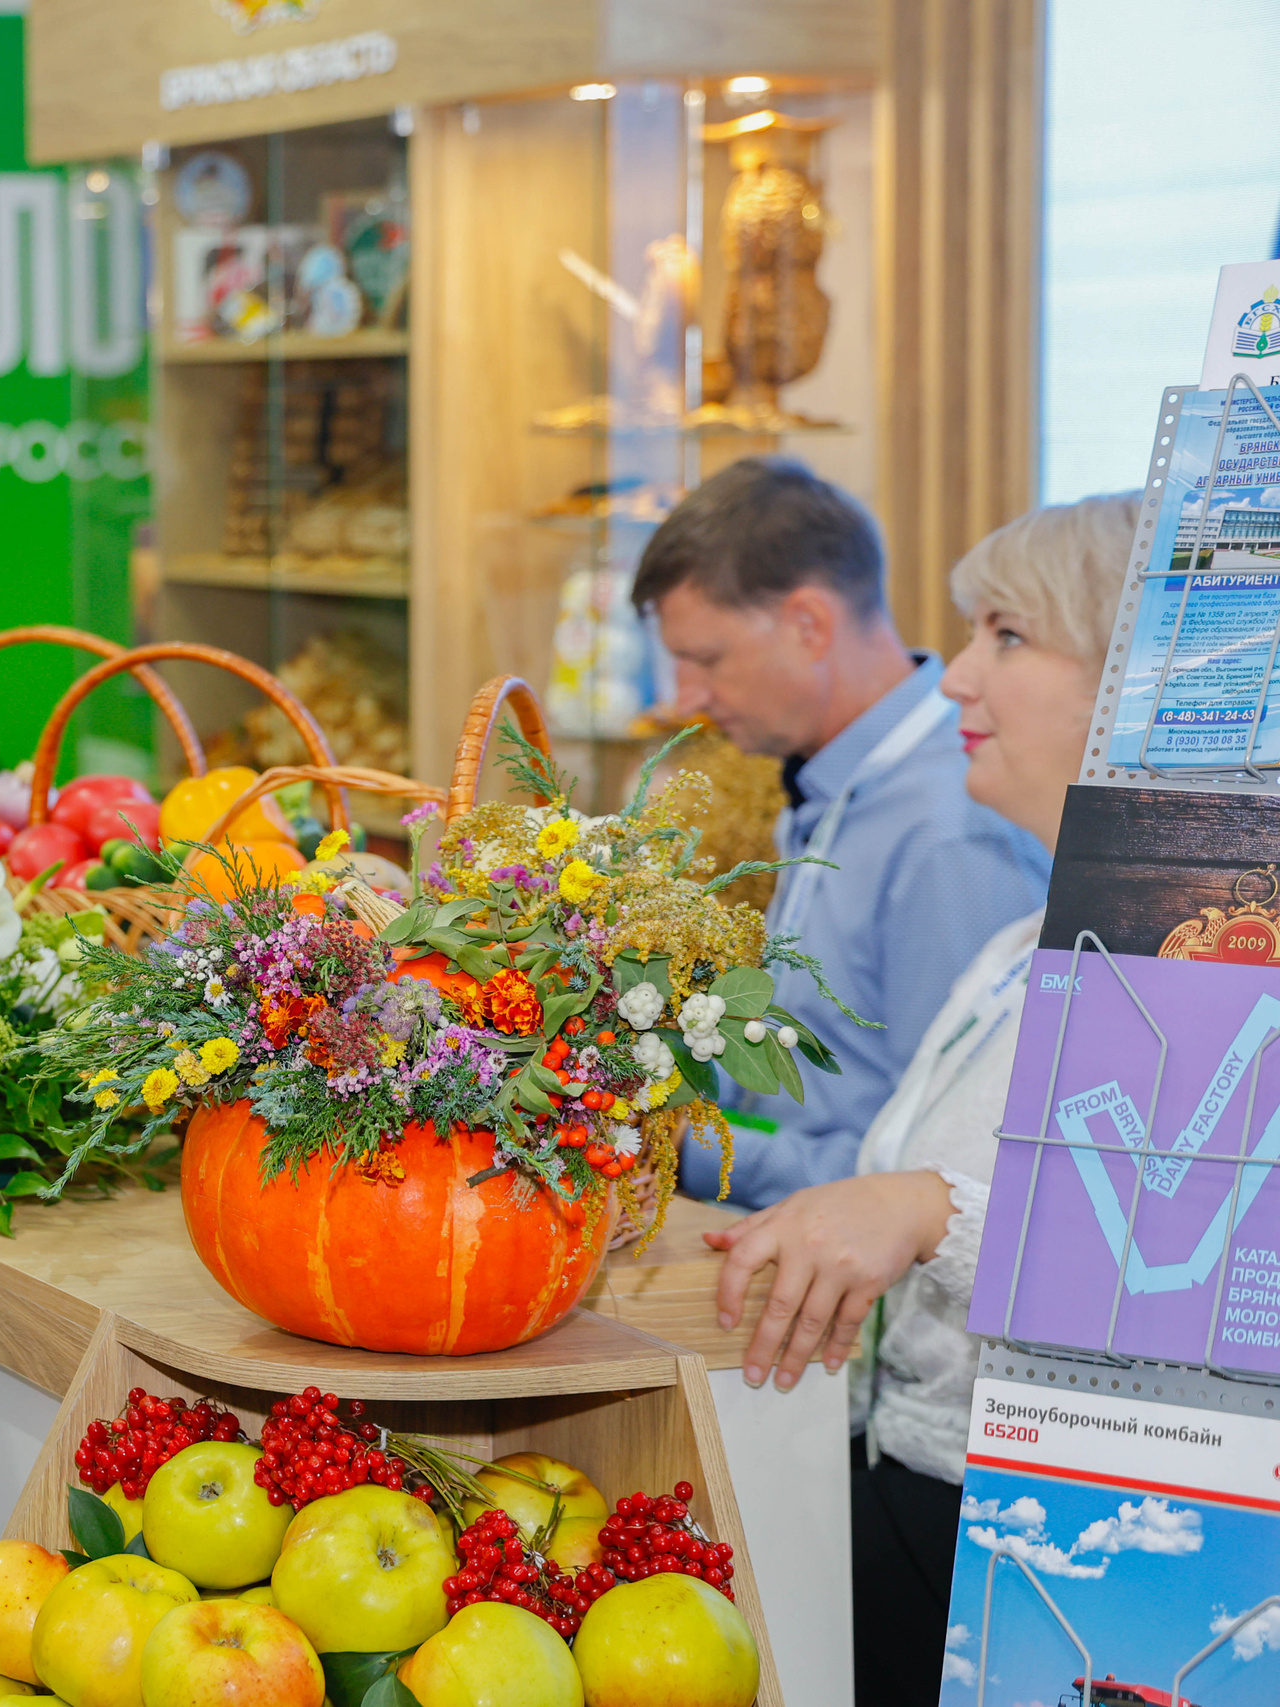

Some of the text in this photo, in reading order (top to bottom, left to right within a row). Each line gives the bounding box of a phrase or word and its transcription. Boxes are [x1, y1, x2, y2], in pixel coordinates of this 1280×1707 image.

[1218, 456, 1280, 471] ОСУДАРСТВ
[1195, 473, 1252, 487] АГАРНЫЙ
[1175, 699, 1207, 708] Телефон
[1162, 708, 1256, 723] (8-48)-341-24-63
[1166, 734, 1247, 747] 8 (930) 730 08 35
[1227, 935, 1267, 952] 2009
[1063, 1086, 1119, 1119] FROM
[1192, 1050, 1244, 1137] FACTORY
[1113, 1100, 1163, 1186] BRYASK
[1234, 1247, 1280, 1267] КАТА
[1224, 1306, 1280, 1327] МОЛО
[984, 1397, 1223, 1447] Зерноуборочный комбайн
[983, 1422, 1039, 1444] GS200
